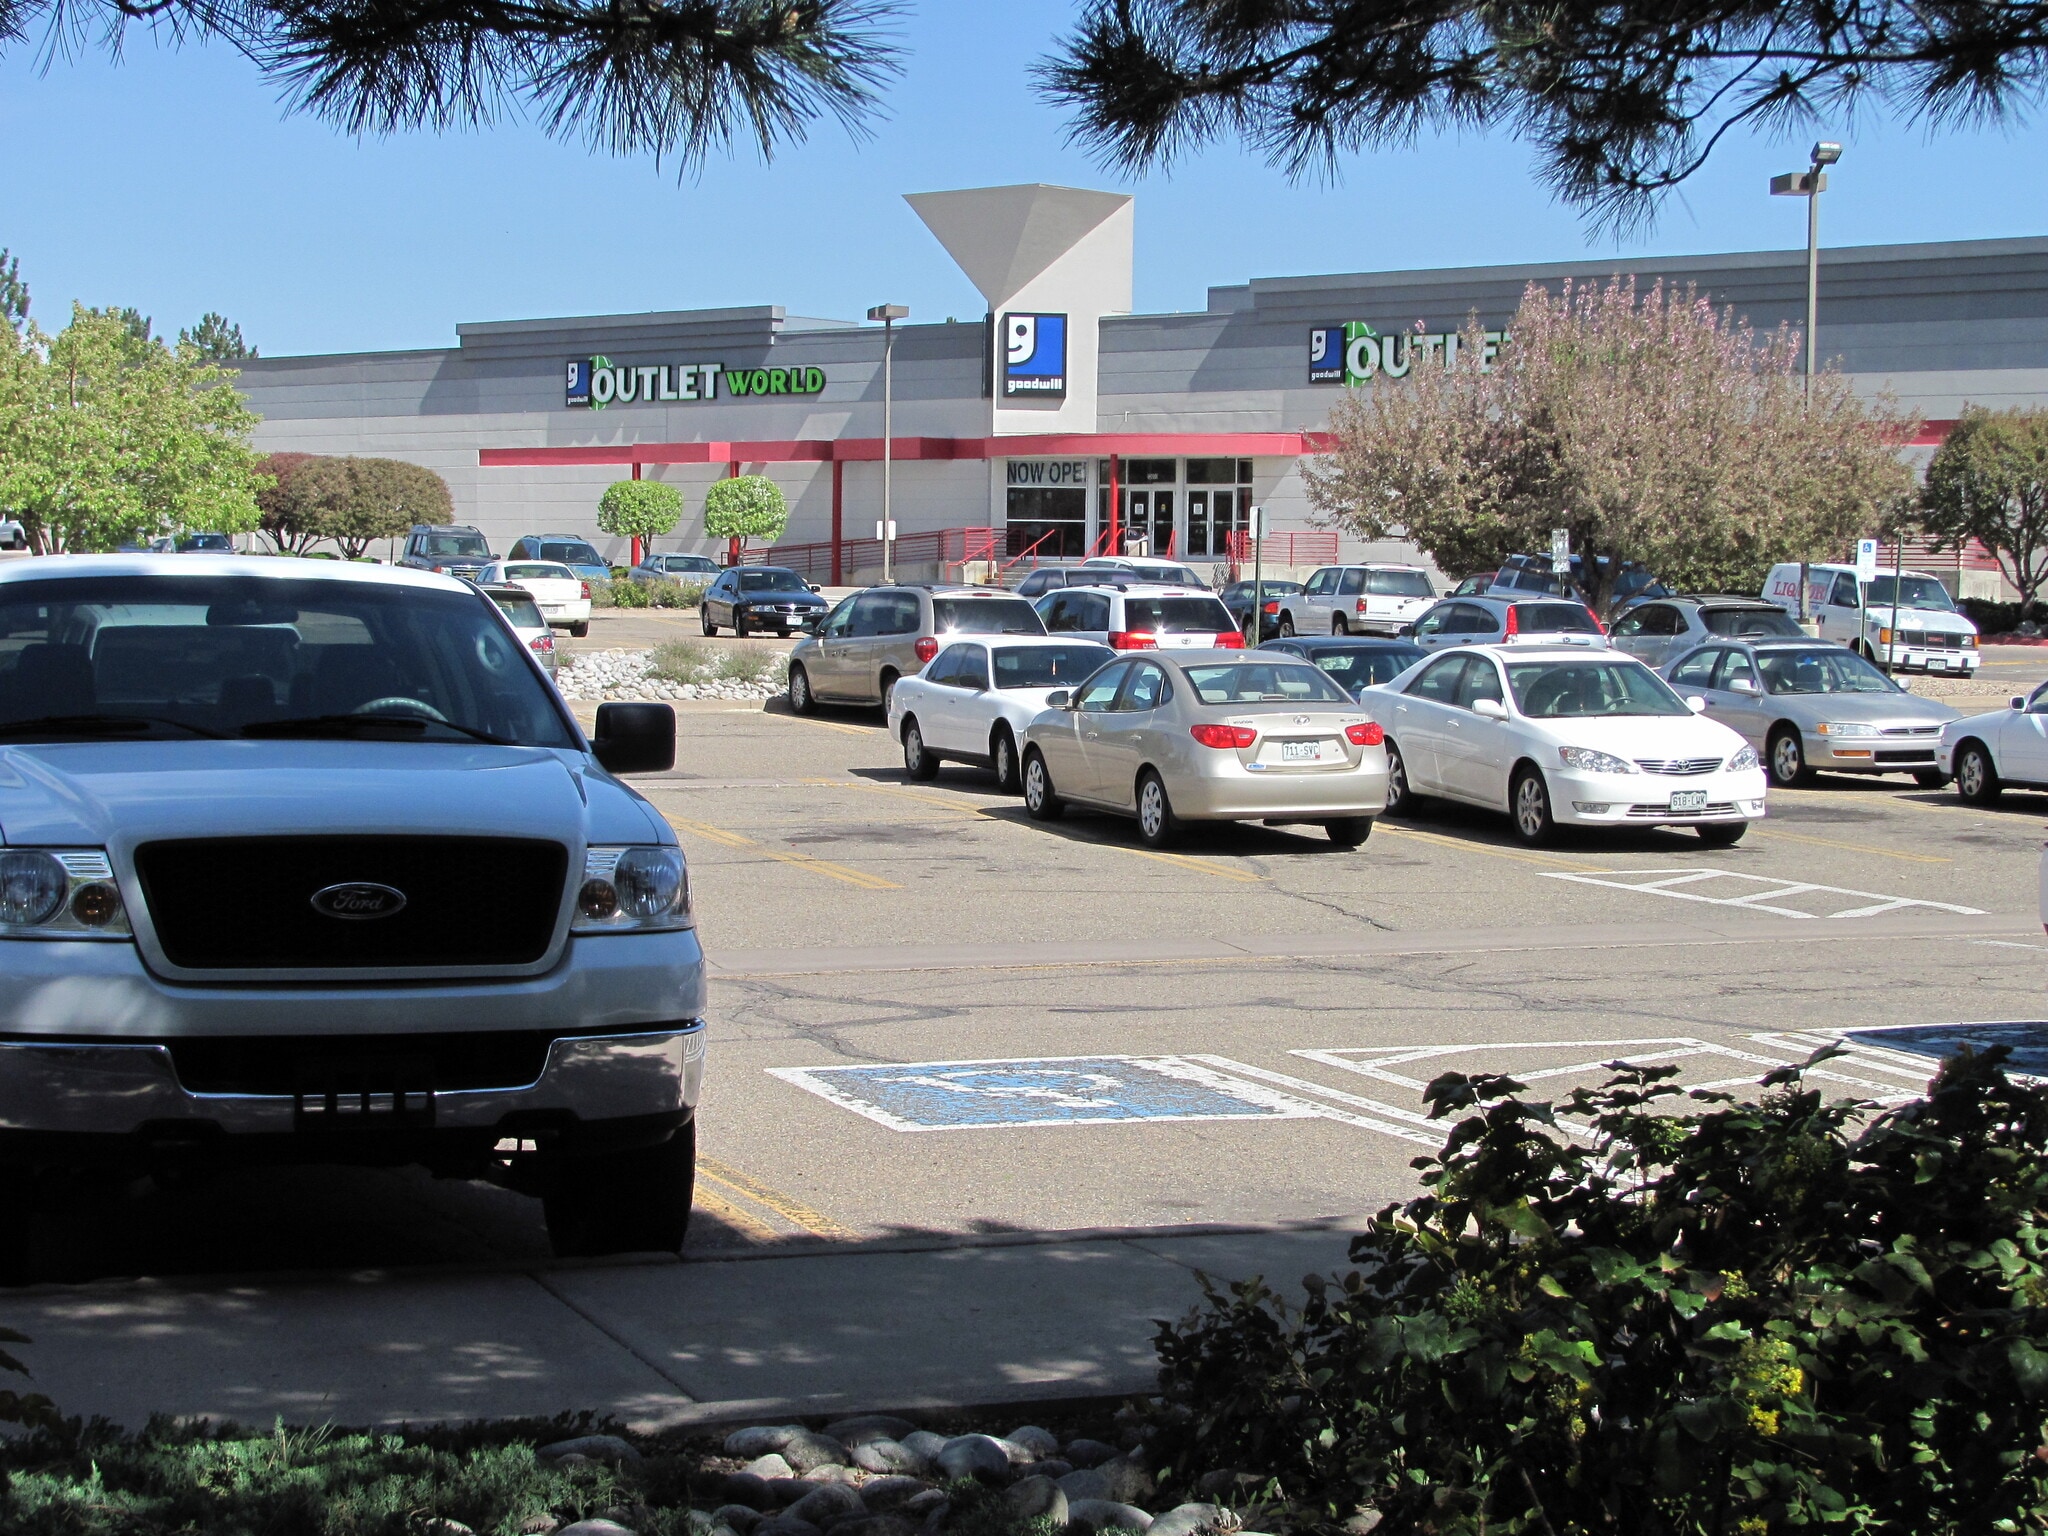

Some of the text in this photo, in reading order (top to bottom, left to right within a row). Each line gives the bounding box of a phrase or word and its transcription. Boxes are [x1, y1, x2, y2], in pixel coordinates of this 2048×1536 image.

[1346, 331, 1513, 379] OUTLE
[591, 363, 826, 403] OUTLET WORLD
[1008, 378, 1063, 393] goodwill
[1007, 462, 1087, 483] NOW OPE
[1773, 581, 1827, 600] LIQOR
[333, 889, 384, 910] Ford
